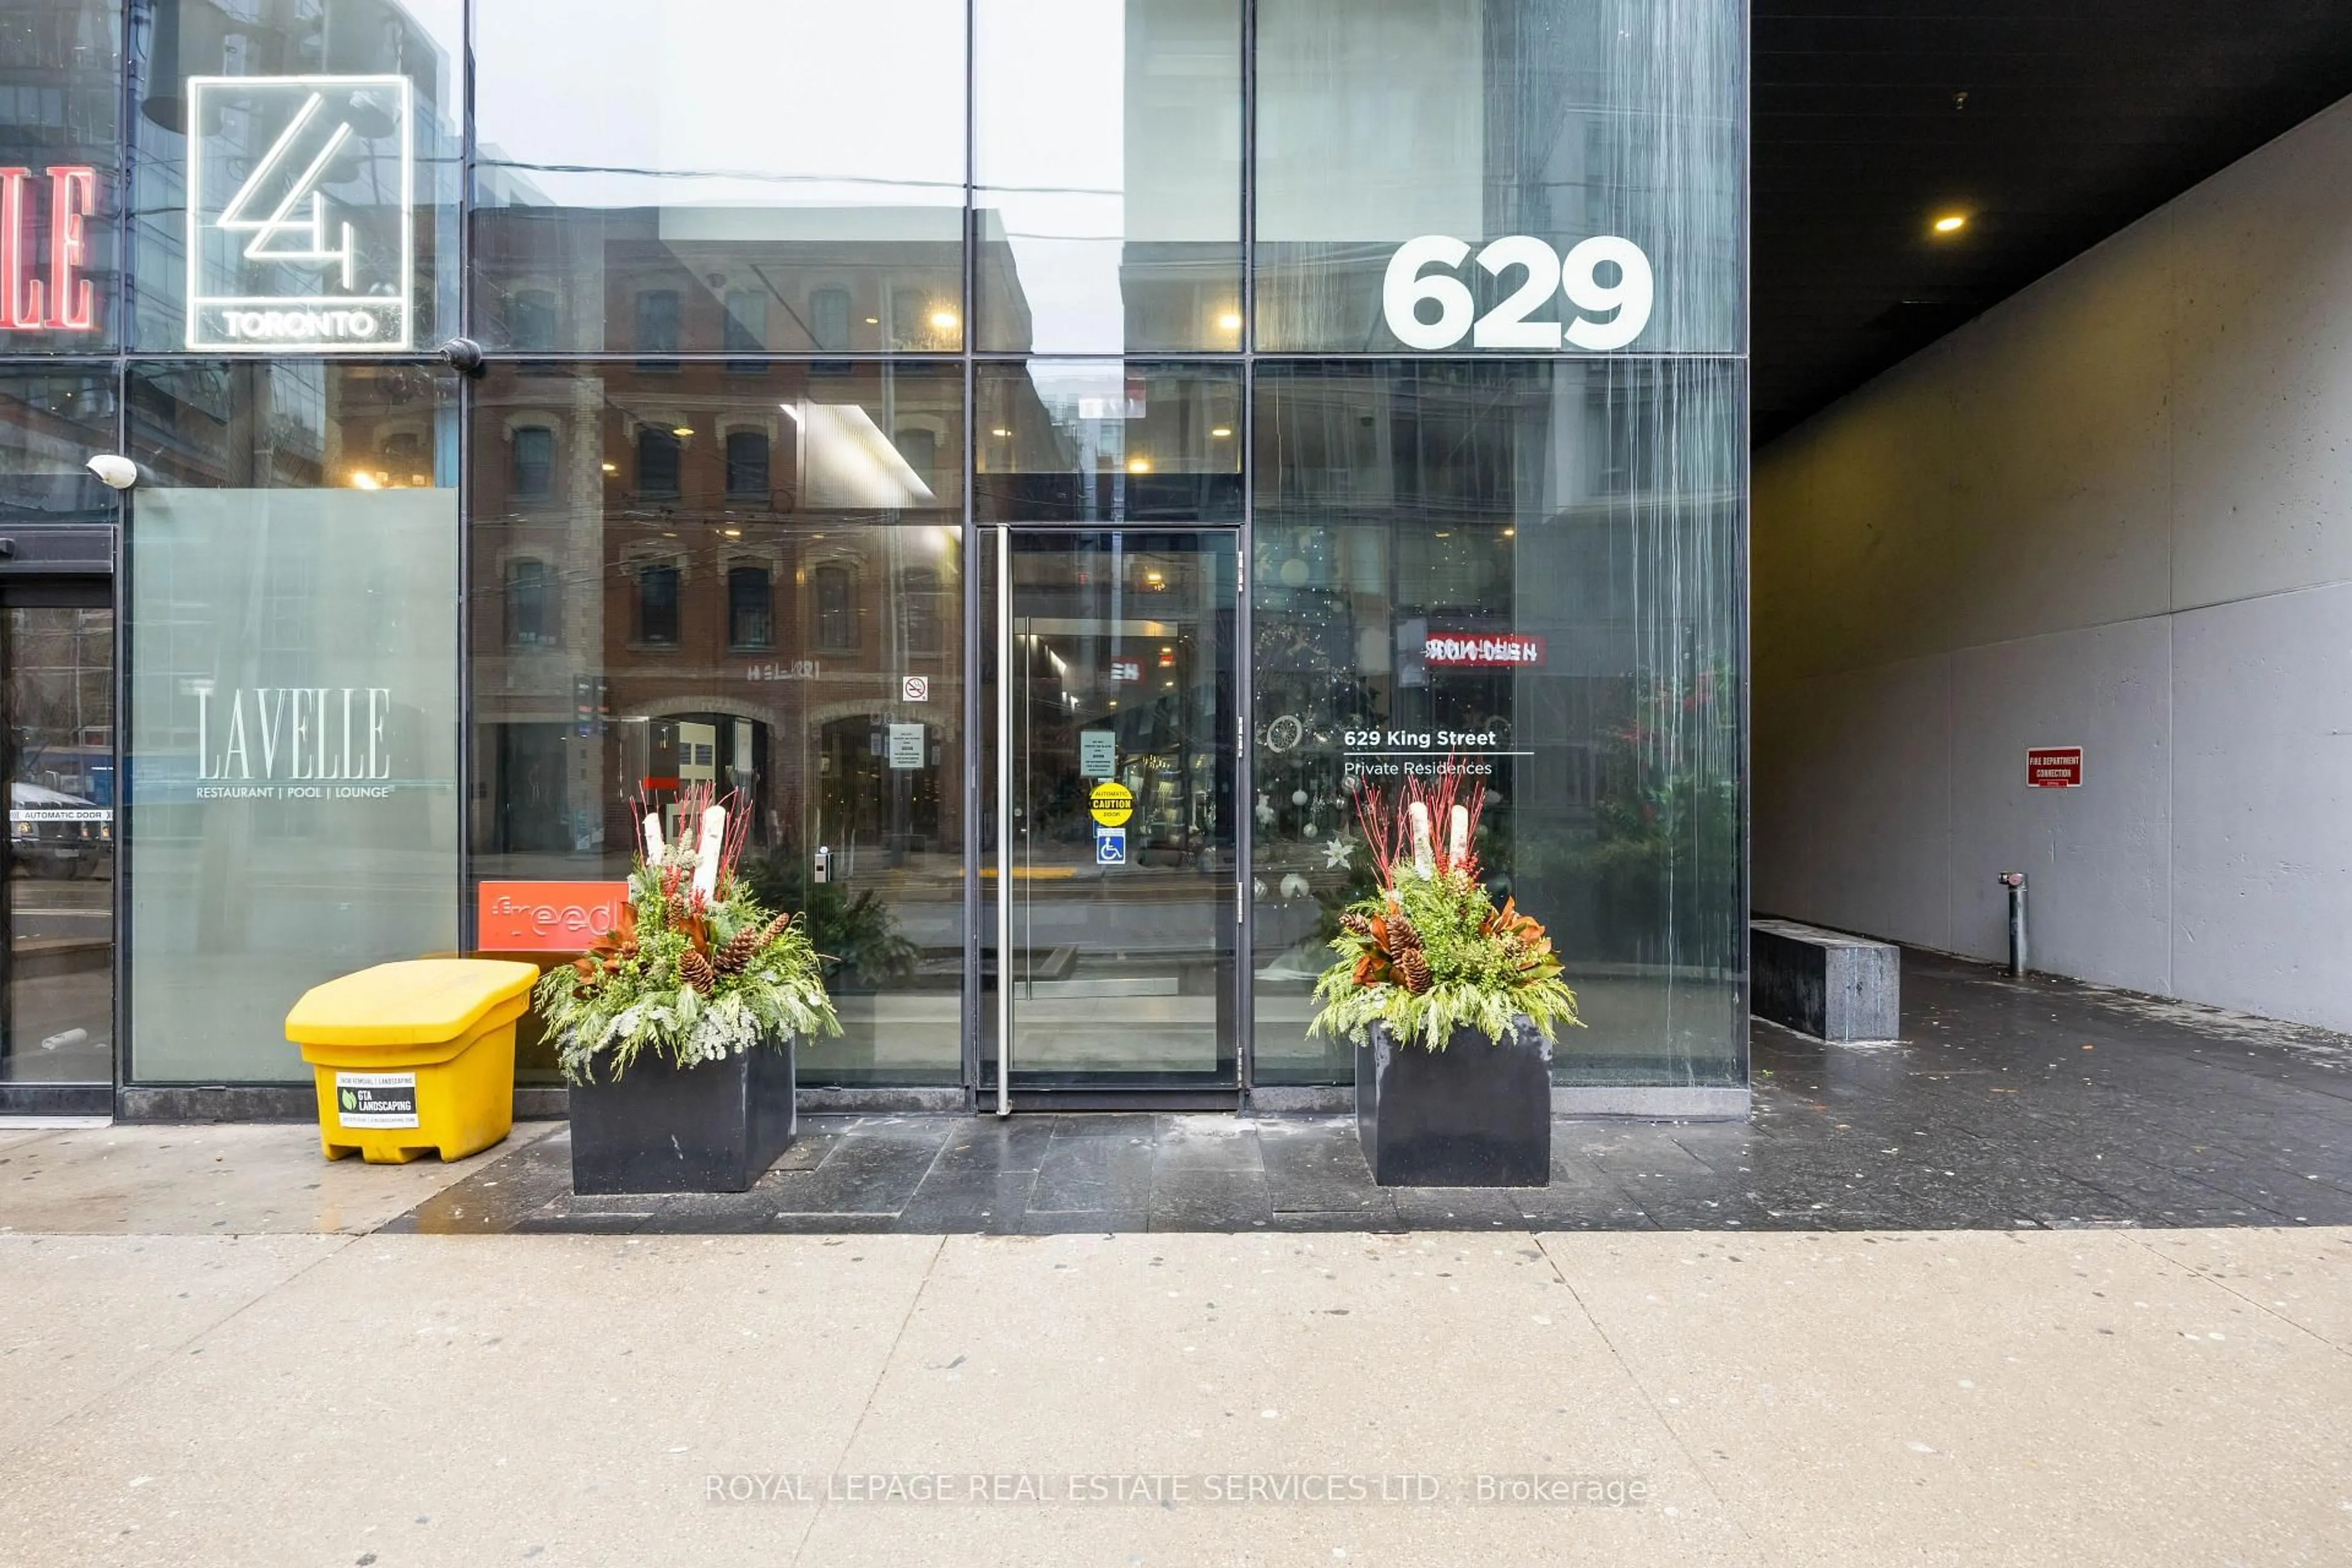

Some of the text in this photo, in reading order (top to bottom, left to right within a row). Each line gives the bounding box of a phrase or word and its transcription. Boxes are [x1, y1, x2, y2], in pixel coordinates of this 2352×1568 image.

[1383, 235, 1653, 350] 629
[221, 311, 377, 337] TORONTO
[196, 687, 391, 780] LAVELLE
[1344, 730, 1497, 748] 629 King Street
[2043, 756, 2079, 765] DEPARTMENT
[1344, 761, 1493, 775] Private Residences
[2037, 769, 2071, 778] CONNECTION
[197, 787, 390, 798] RESTAURANT POOL LOUNGE
[1093, 800, 1131, 809] CAUTION
[358, 1090, 372, 1101] GTA
[359, 1101, 412, 1111] LANDSCAPING
